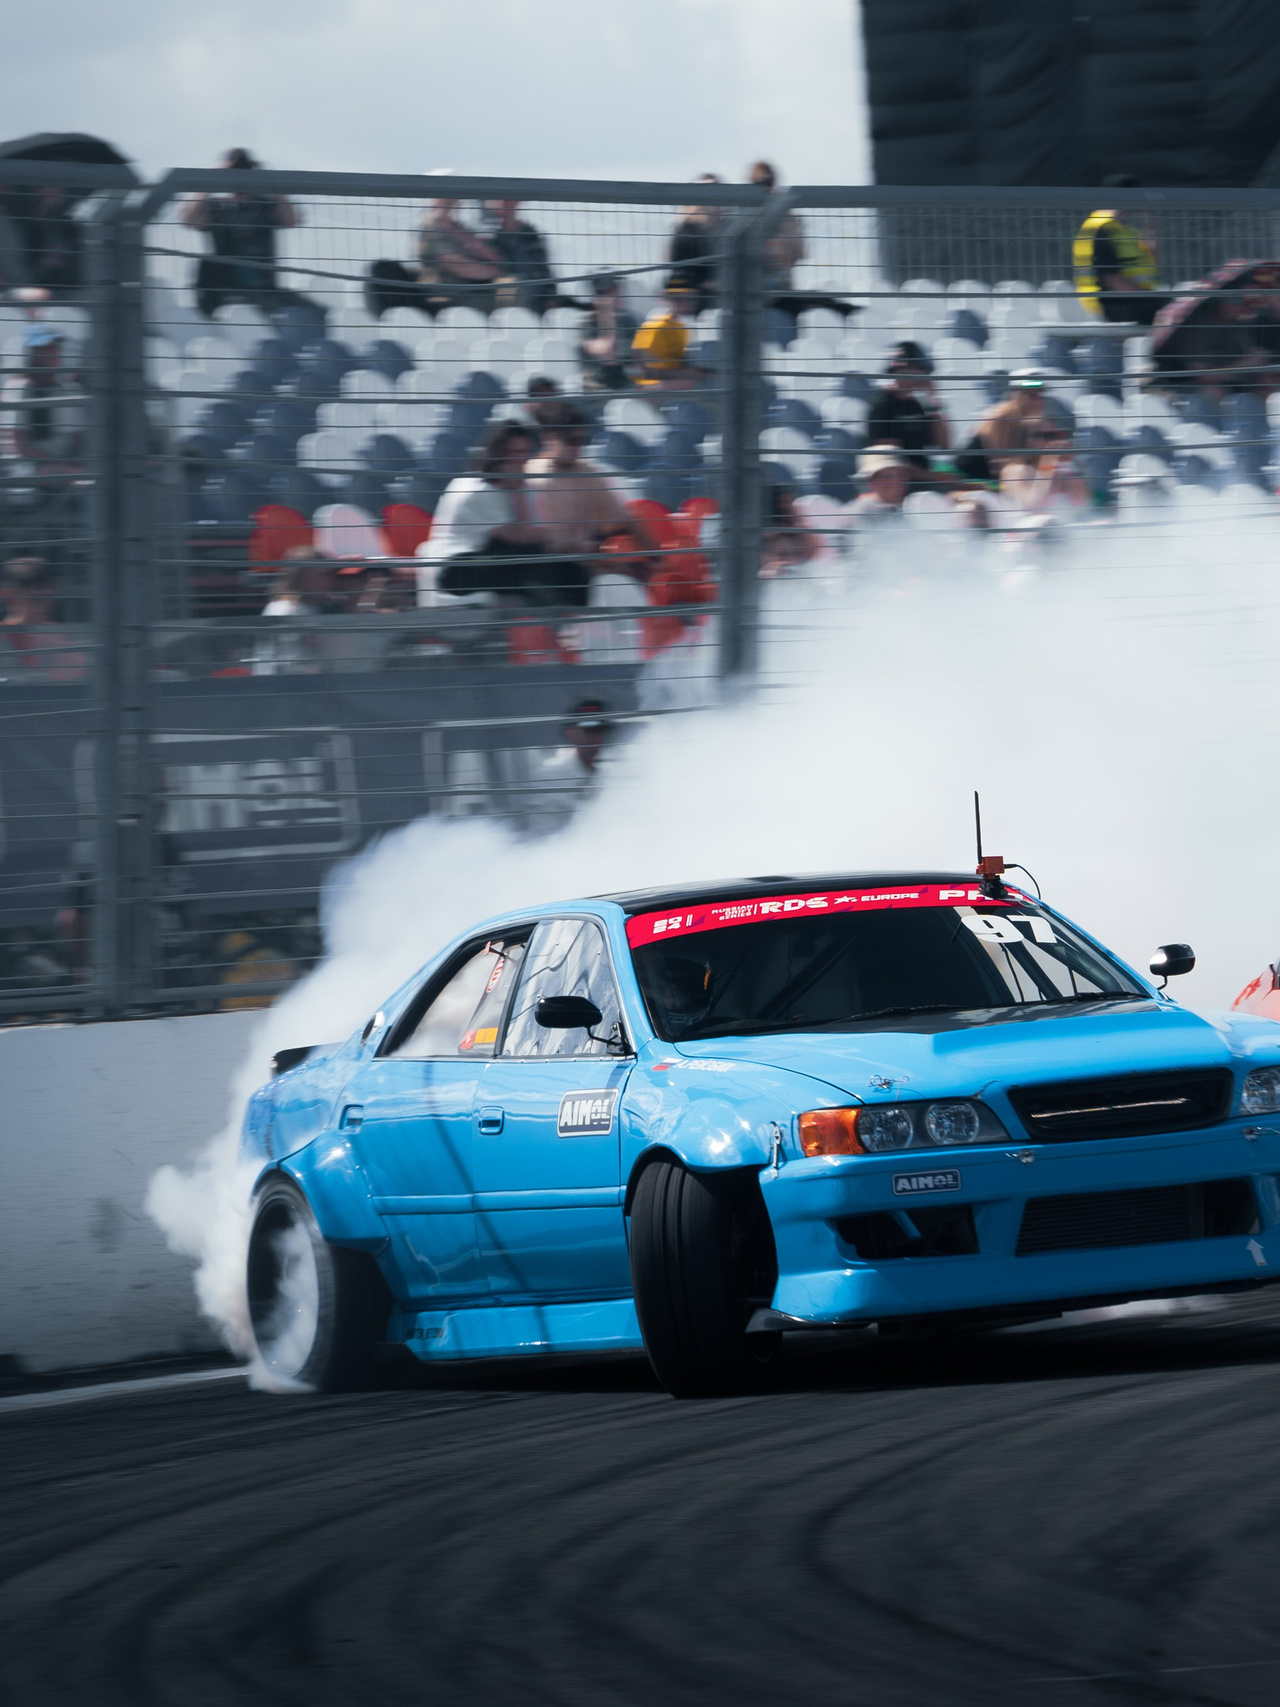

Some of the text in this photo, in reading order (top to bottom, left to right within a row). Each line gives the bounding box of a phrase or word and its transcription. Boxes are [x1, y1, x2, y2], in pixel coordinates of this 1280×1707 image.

[759, 897, 829, 915] RDS
[861, 893, 919, 902] EUROPE
[961, 914, 1058, 943] 97
[559, 1098, 611, 1127] AIMOL
[896, 1174, 958, 1191] AIMOL
